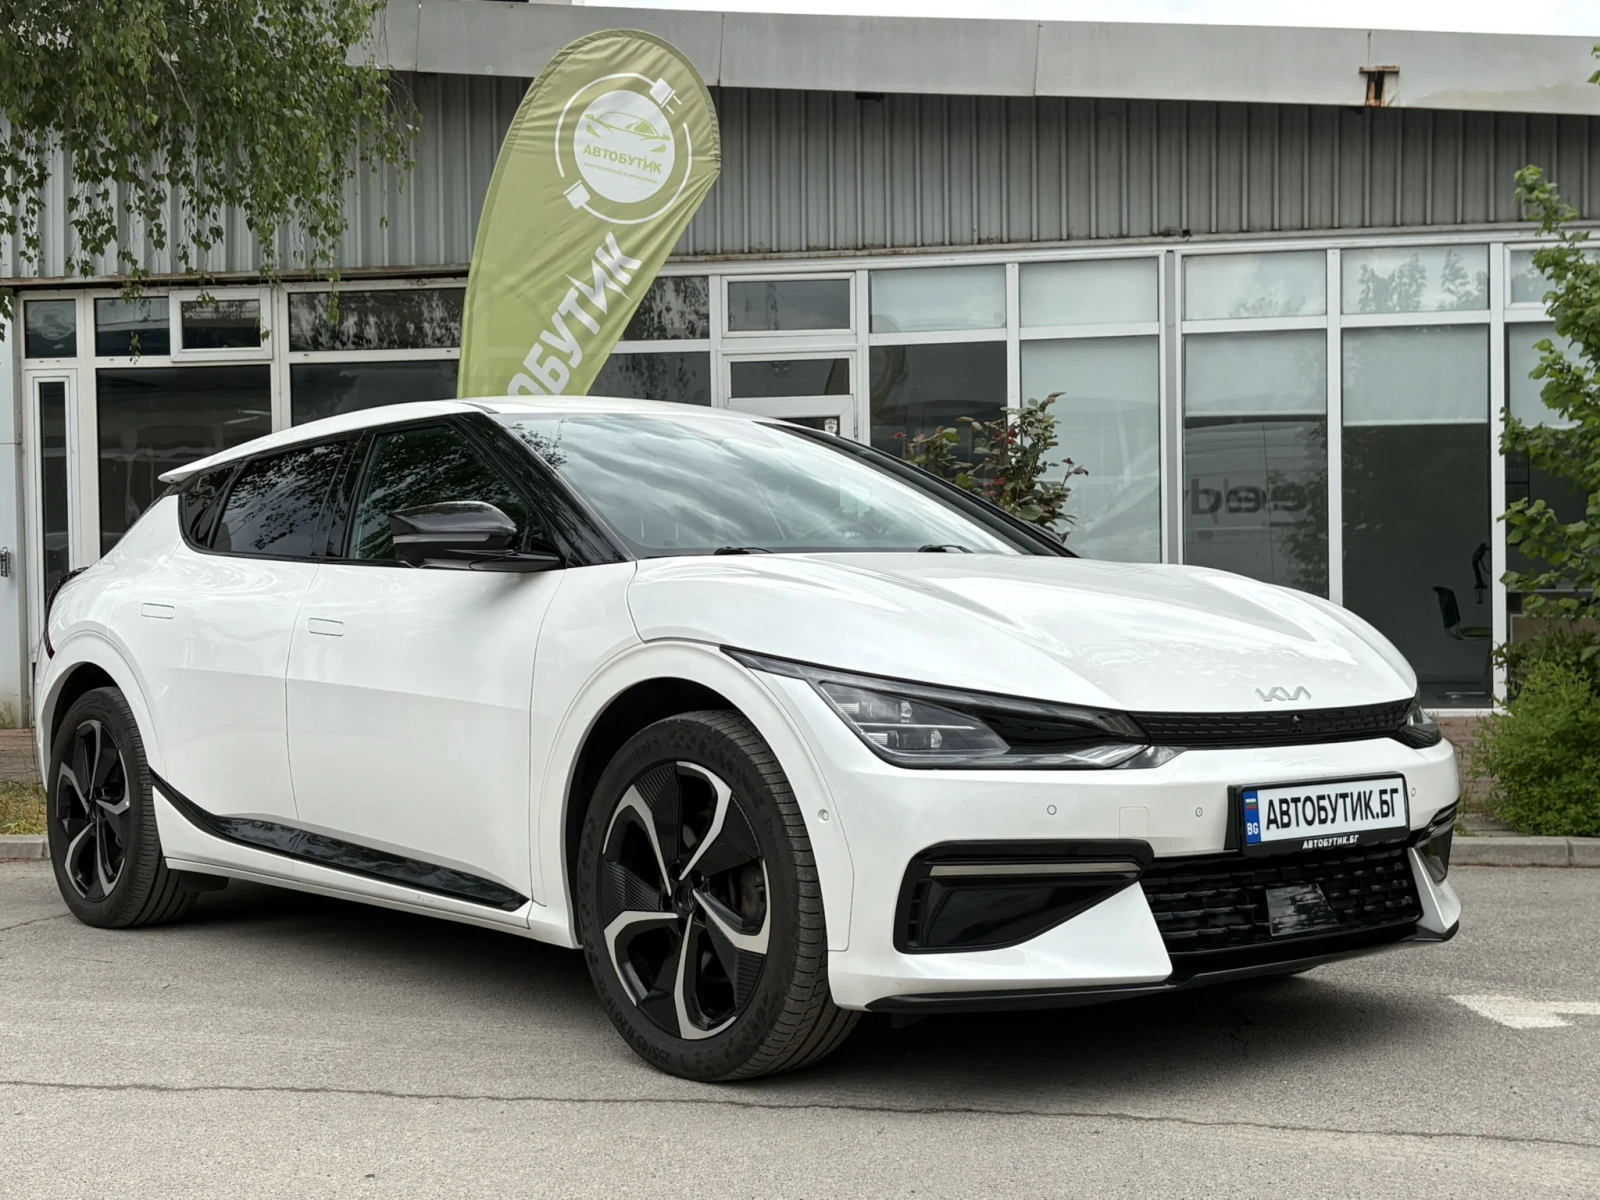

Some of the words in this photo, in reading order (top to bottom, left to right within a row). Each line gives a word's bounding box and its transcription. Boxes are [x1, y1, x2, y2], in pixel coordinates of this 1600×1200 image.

[583, 144, 663, 176] АВТОБУТИК
[1266, 788, 1399, 831] АВТОБУТИК.БГ
[1246, 822, 1259, 835] BG
[1302, 834, 1359, 850] АВТОБУТИК.БГ
